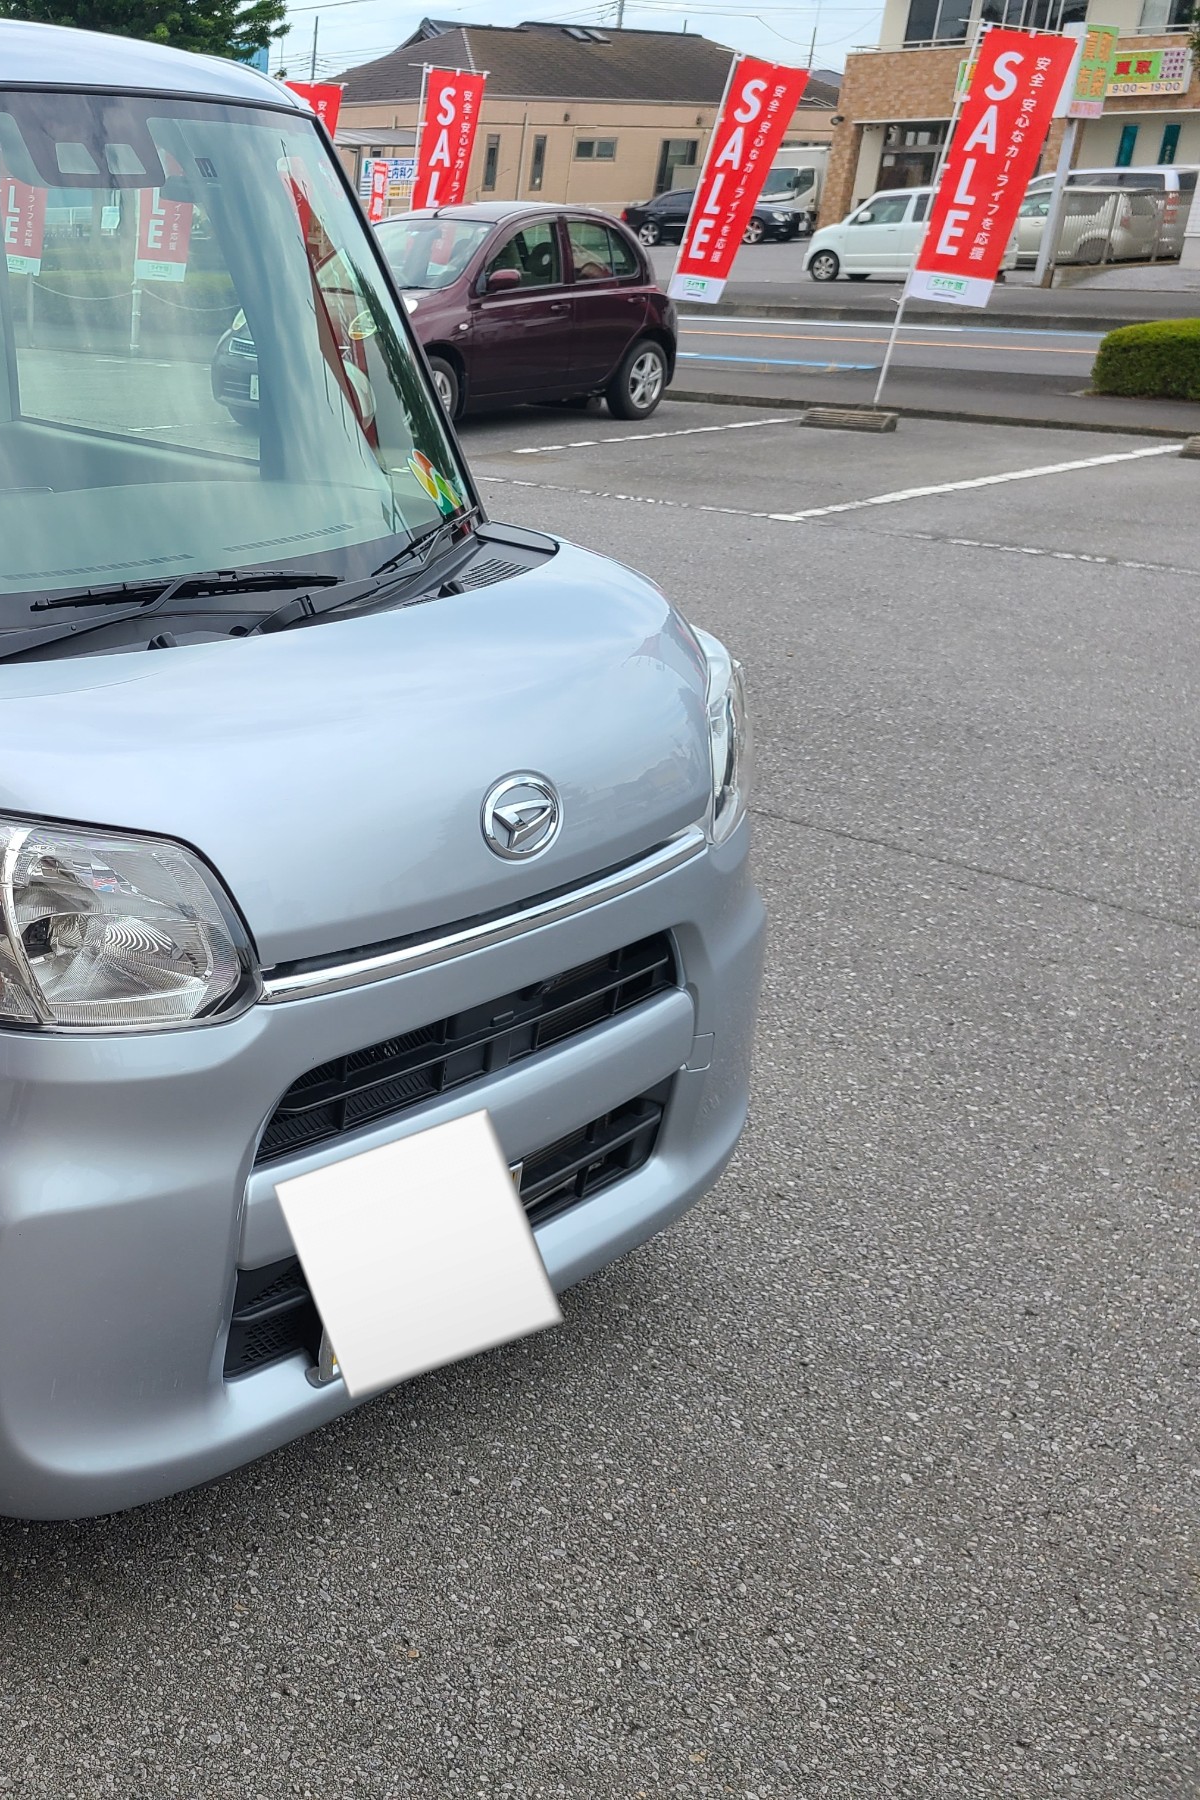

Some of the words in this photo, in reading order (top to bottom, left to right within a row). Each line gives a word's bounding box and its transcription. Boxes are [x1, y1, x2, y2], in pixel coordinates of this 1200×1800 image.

[933, 50, 1024, 257] SALE
[1114, 61, 1152, 76] 買取
[688, 79, 769, 260] SALE
